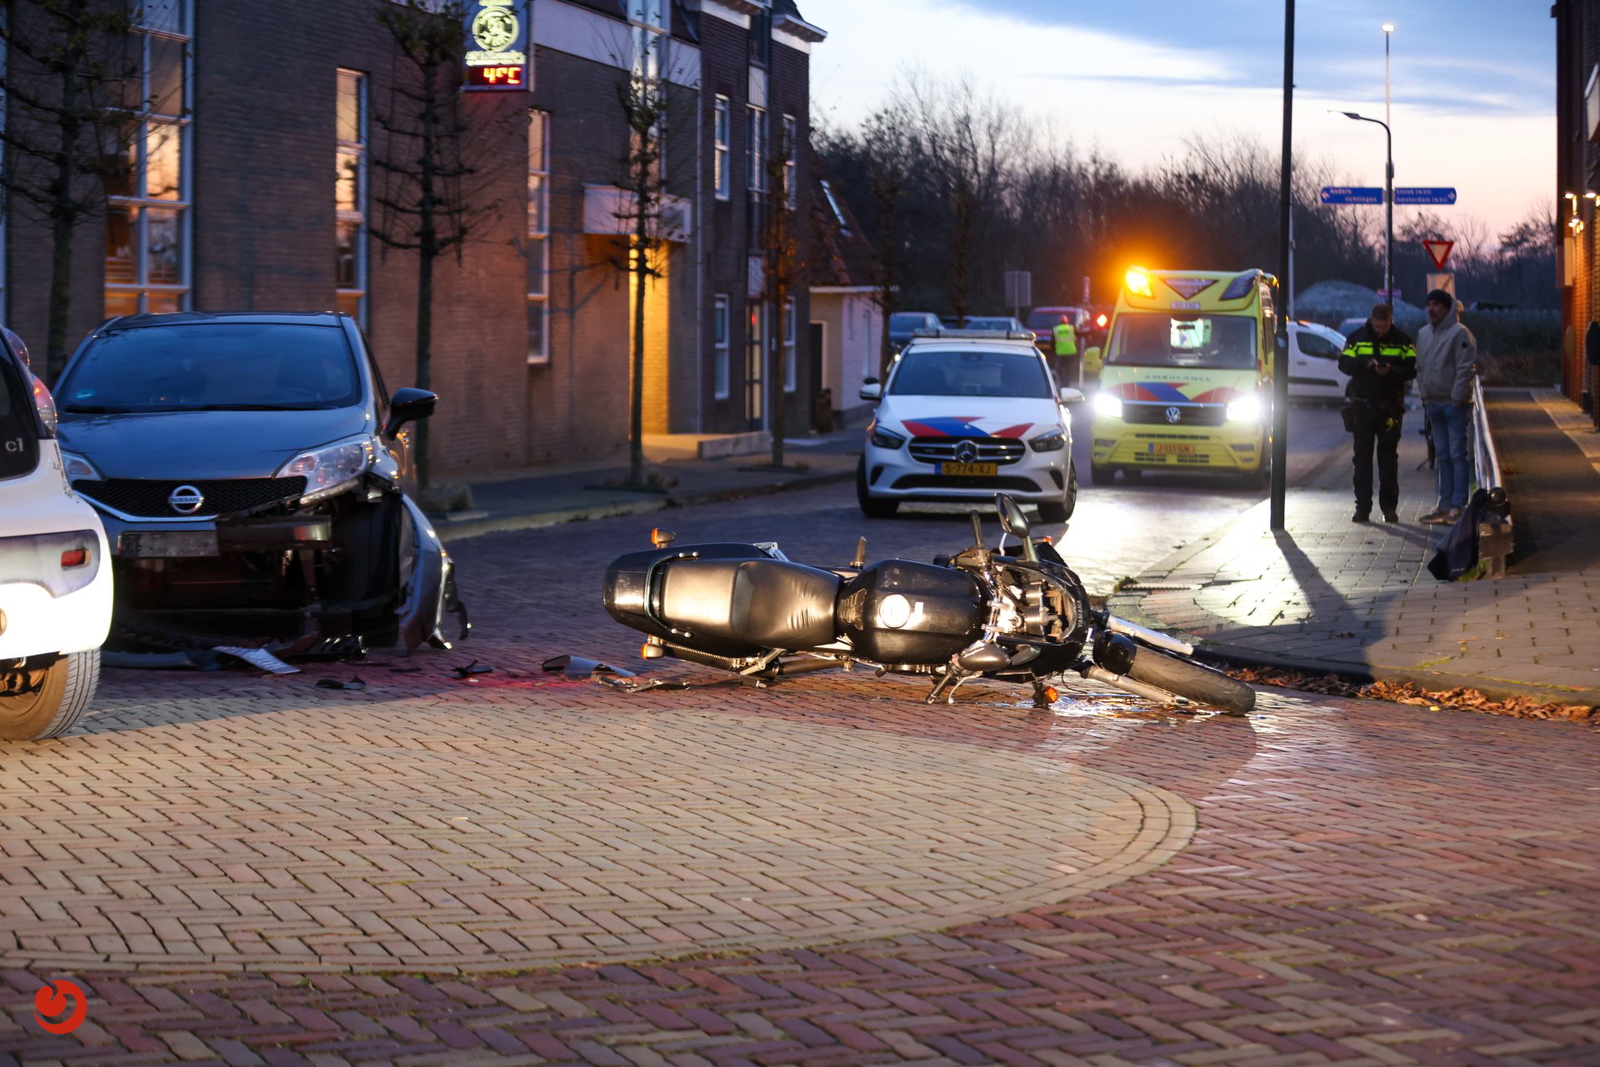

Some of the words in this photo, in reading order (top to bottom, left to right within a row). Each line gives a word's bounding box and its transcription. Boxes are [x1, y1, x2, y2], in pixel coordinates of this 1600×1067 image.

[1396, 196, 1431, 204] Amsterdam
[1144, 374, 1210, 382] AMBULANCE
[944, 463, 990, 474] S-774-XJ
[1076, 599, 1084, 628] YAMAHA
